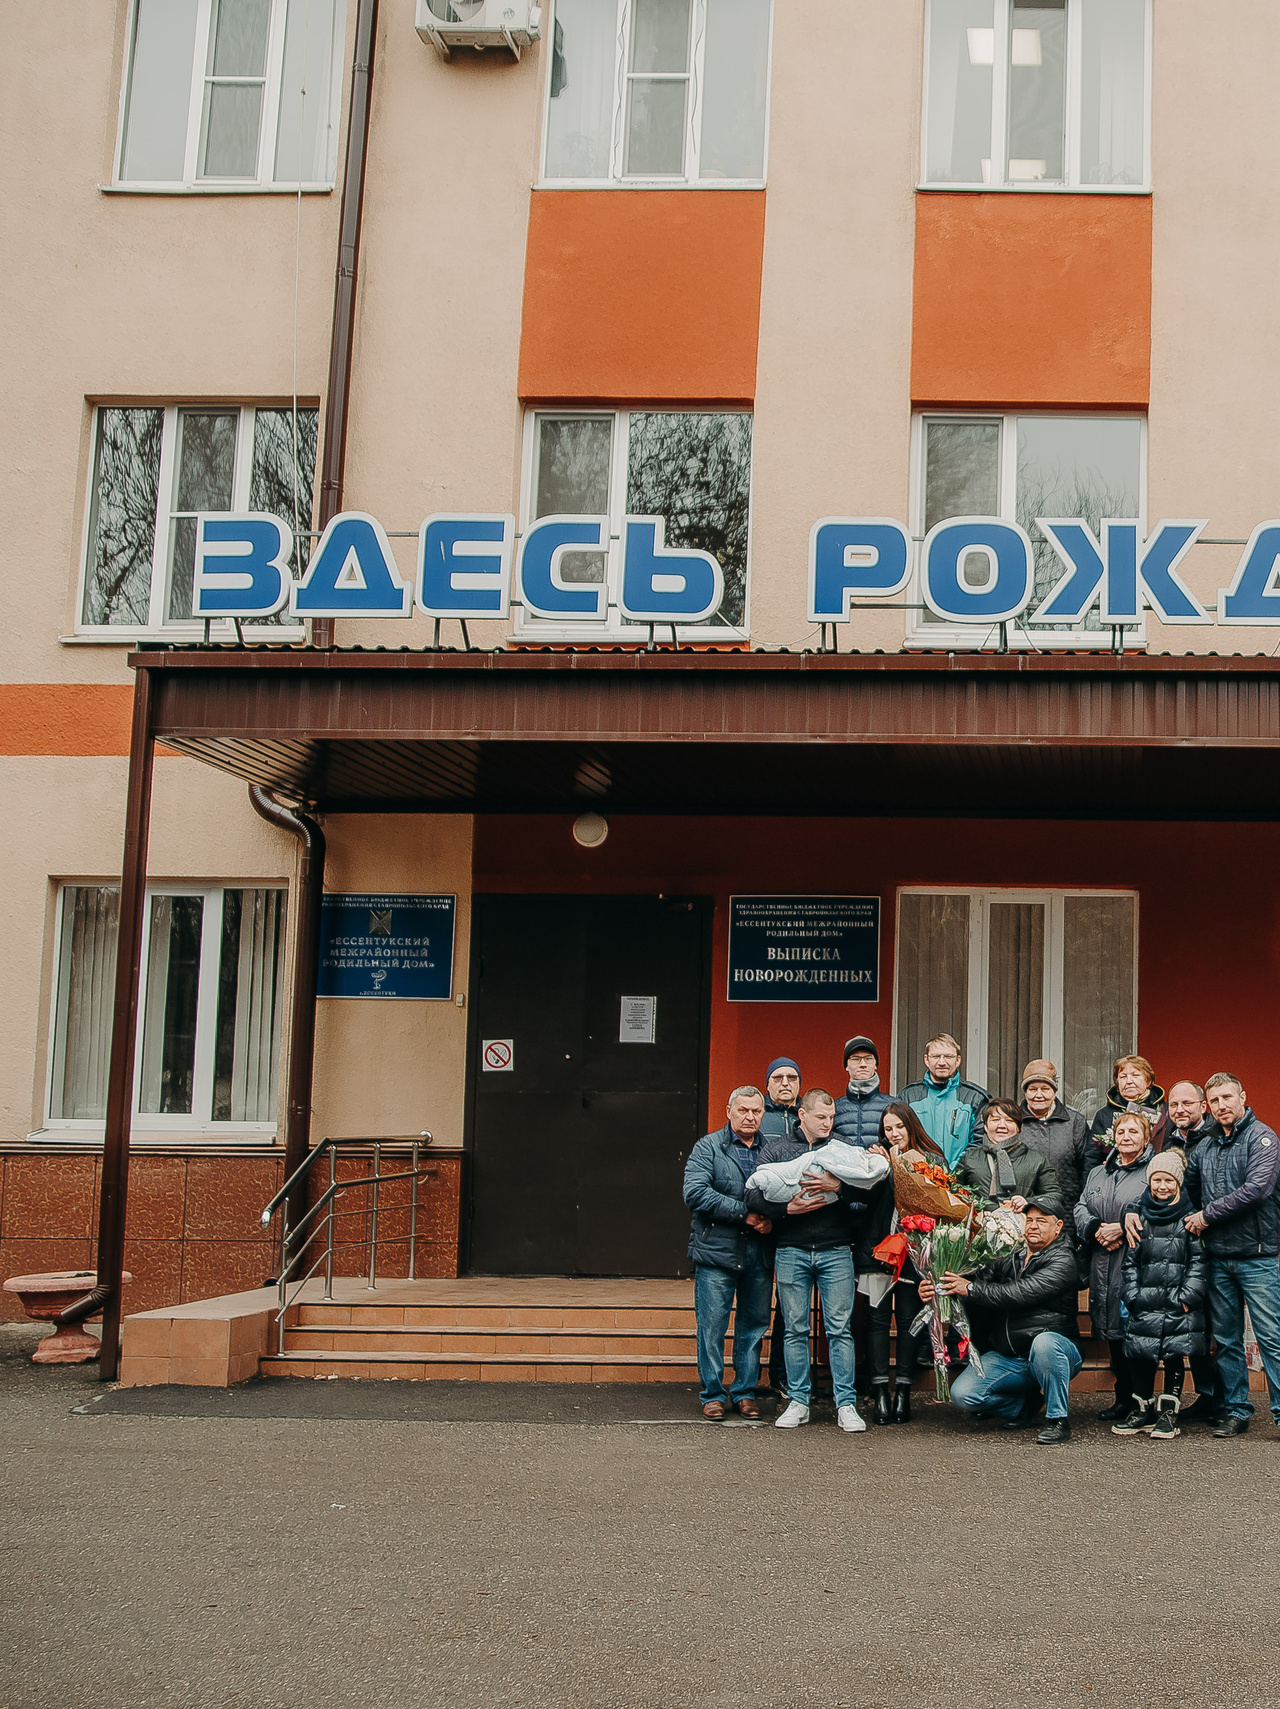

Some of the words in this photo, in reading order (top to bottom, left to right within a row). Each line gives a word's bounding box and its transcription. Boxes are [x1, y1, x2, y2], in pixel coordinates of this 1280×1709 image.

[197, 512, 724, 621] ЗДЕСЬ
[736, 919, 805, 927] «ЕССЕНТУКСКИЙ
[807, 919, 874, 927] МЕЖРАЙОННЫЙ
[766, 929, 819, 937] РОДИЛЬНЫЙ
[820, 930, 843, 938] ДОМ»
[330, 936, 430, 946] «ЕССЕНТУКСКИЙ
[330, 947, 428, 957] МЕЖРАЙОННЫЙ
[767, 947, 841, 960] ВЫПИСКА
[323, 958, 399, 968] РОДИЛЬНЫЙ
[402, 959, 435, 969] ДОМ»
[734, 968, 873, 984] НОВОРОЖДЕННЫХ
